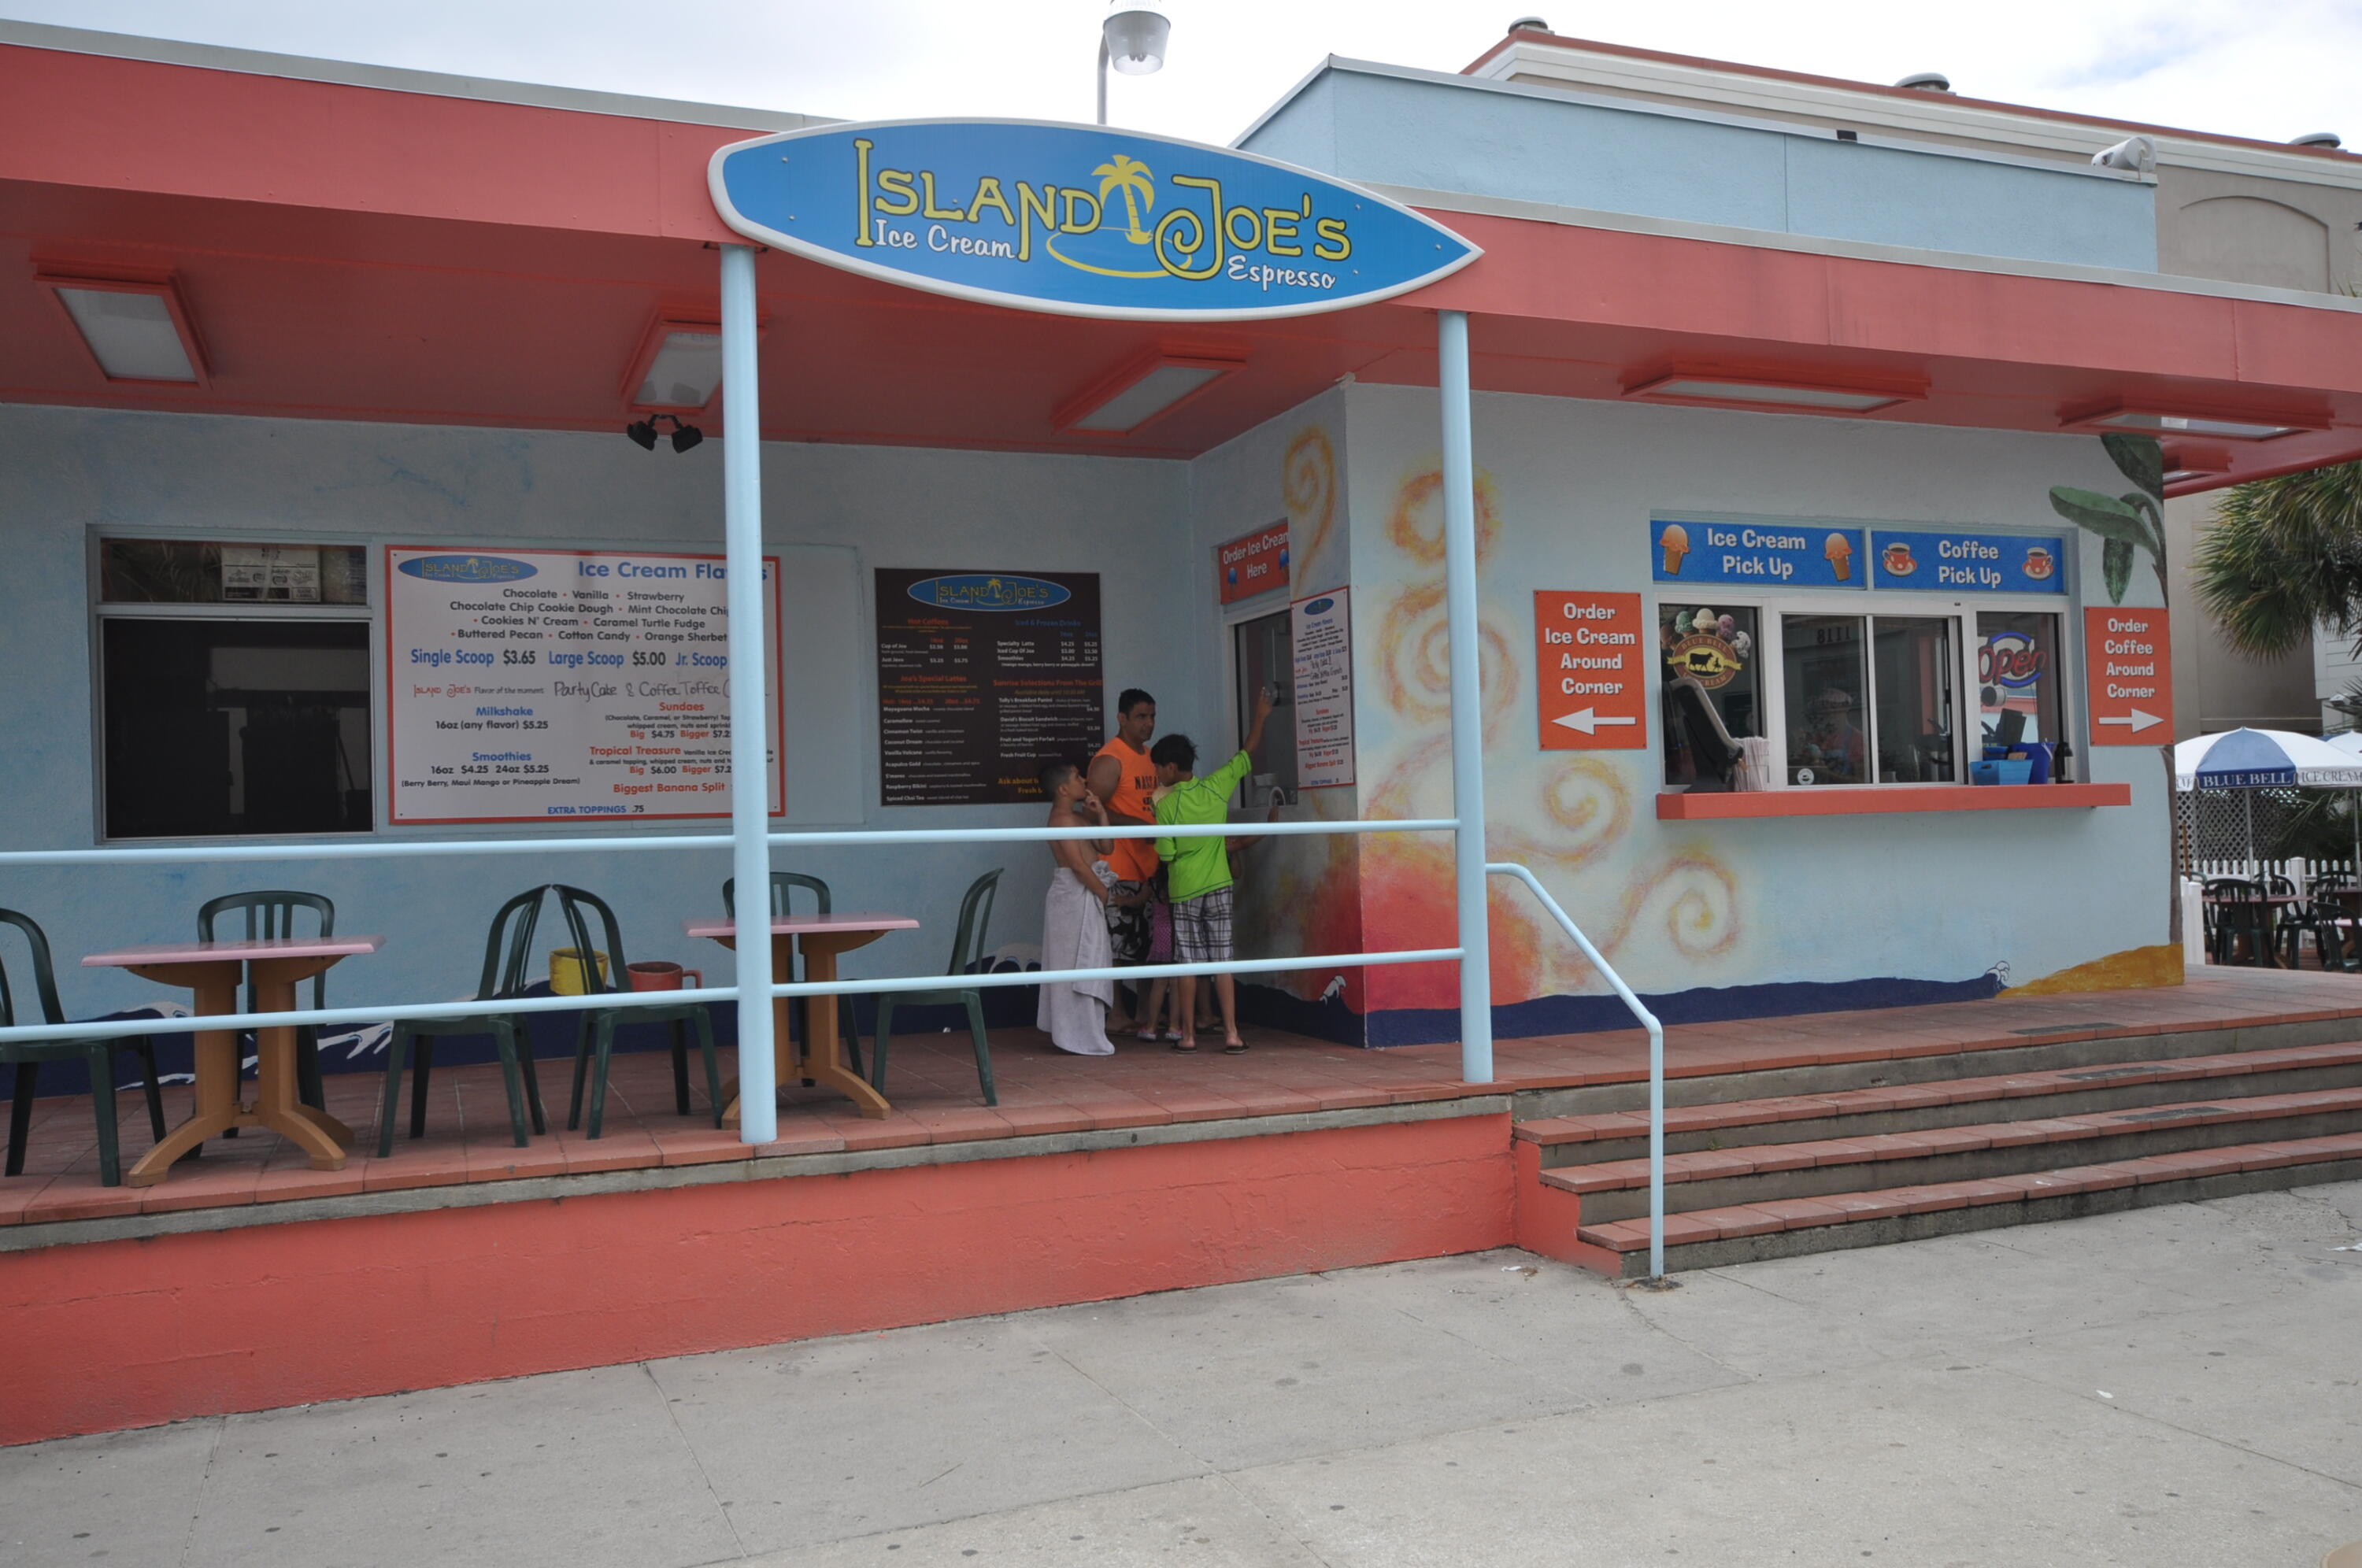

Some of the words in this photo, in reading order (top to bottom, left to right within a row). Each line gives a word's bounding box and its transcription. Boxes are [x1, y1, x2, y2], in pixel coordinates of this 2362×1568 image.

[876, 219, 918, 248] Ice
[927, 224, 1016, 259] Cream
[1227, 254, 1336, 291] Espresso
[1707, 527, 1737, 546] Ice
[1742, 529, 1806, 549] Cream
[1223, 546, 1246, 565] Order
[1248, 542, 1261, 556] Ice
[1938, 540, 1999, 559] Coffee
[579, 561, 609, 577] Ice
[618, 562, 687, 579] Cream
[696, 564, 768, 579] Flas
[1247, 563, 1268, 579] Here
[1723, 555, 1764, 575] Pick
[1769, 557, 1794, 580] Up
[1938, 566, 1976, 584] Pick
[1980, 568, 2001, 588] Up
[503, 589, 557, 599] Chocolate
[572, 590, 609, 600] Vanilla
[628, 592, 684, 602] Strawberry
[450, 601, 505, 612] Chocolate
[510, 603, 534, 613] Chip
[539, 603, 575, 612] Cookie
[579, 605, 613, 615] Dough
[655, 606, 706, 615] Chocolate
[1563, 602, 1616, 619] Order
[481, 616, 524, 625] Cookies
[543, 617, 579, 626] Cream
[642, 619, 671, 627] Turtle
[674, 619, 705, 630] Fudge
[2108, 618, 2149, 633] Order
[457, 630, 505, 639] Buttered
[510, 631, 542, 639] Pecan
[558, 631, 593, 641] Cotton
[598, 632, 630, 642] Candy
[645, 633, 684, 643] Orange
[687, 633, 727, 642] Sherbet
[1545, 627, 1572, 644] Ice
[1577, 627, 1636, 645] Cream
[2105, 639, 2153, 654] Coffee
[411, 649, 451, 668] Single
[456, 649, 494, 668] Scoop
[503, 649, 535, 666] $3.65
[549, 651, 583, 668] Large
[587, 651, 624, 668] Scoop
[632, 651, 666, 667] $5.00
[676, 653, 688, 666] Jr.
[692, 653, 727, 670] Scoop
[1560, 653, 1622, 669] Around
[1979, 646, 2048, 684] Open
[2106, 662, 2154, 676] Around
[553, 682, 591, 702] Party
[591, 682, 617, 697] Cake
[679, 681, 720, 695] Toffee
[1561, 678, 1623, 694] Corner
[2107, 683, 2155, 697] Corner
[476, 707, 533, 716] Milkshake
[660, 702, 705, 712] Sundaes
[461, 720, 483, 730] (any
[487, 720, 519, 730] flavor)
[523, 720, 549, 730] $5.25
[630, 730, 645, 739] Big
[680, 730, 709, 739] Bigger
[472, 753, 531, 761] Smoothies
[590, 746, 632, 757] Tropical
[635, 746, 681, 755] Treasure
[461, 765, 489, 775] $4.25
[524, 764, 549, 774] $5.25
[630, 766, 644, 775] Big
[651, 766, 677, 775] $6.00
[682, 765, 711, 775] Bigger
[715, 765, 731, 774] $7.2
[2301, 772, 2321, 782] ICE
[2203, 774, 2245, 788] BLUE
[2249, 772, 2291, 785] BELL
[613, 784, 653, 795] Biggest
[702, 782, 725, 793] Split
[579, 805, 627, 814] TOPPINGS
